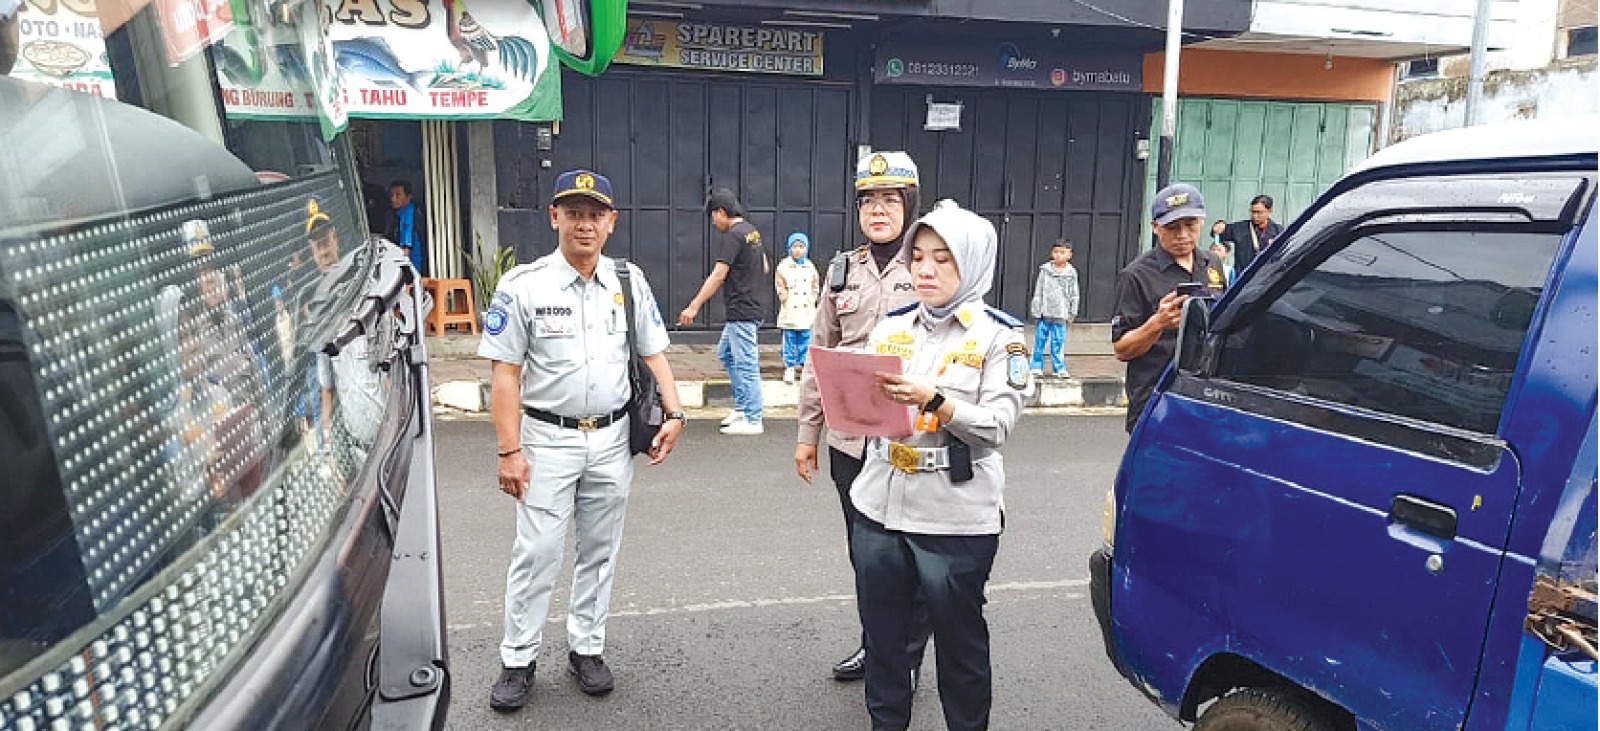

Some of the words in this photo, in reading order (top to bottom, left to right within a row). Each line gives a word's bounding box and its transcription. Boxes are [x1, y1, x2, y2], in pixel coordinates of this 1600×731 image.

[676, 23, 818, 51] SPAREPART
[680, 50, 749, 69] SERVICE
[750, 54, 814, 73] CENTER
[242, 89, 294, 108] BURUNG
[360, 89, 407, 106] TAHU
[428, 91, 489, 108] TEMPE
